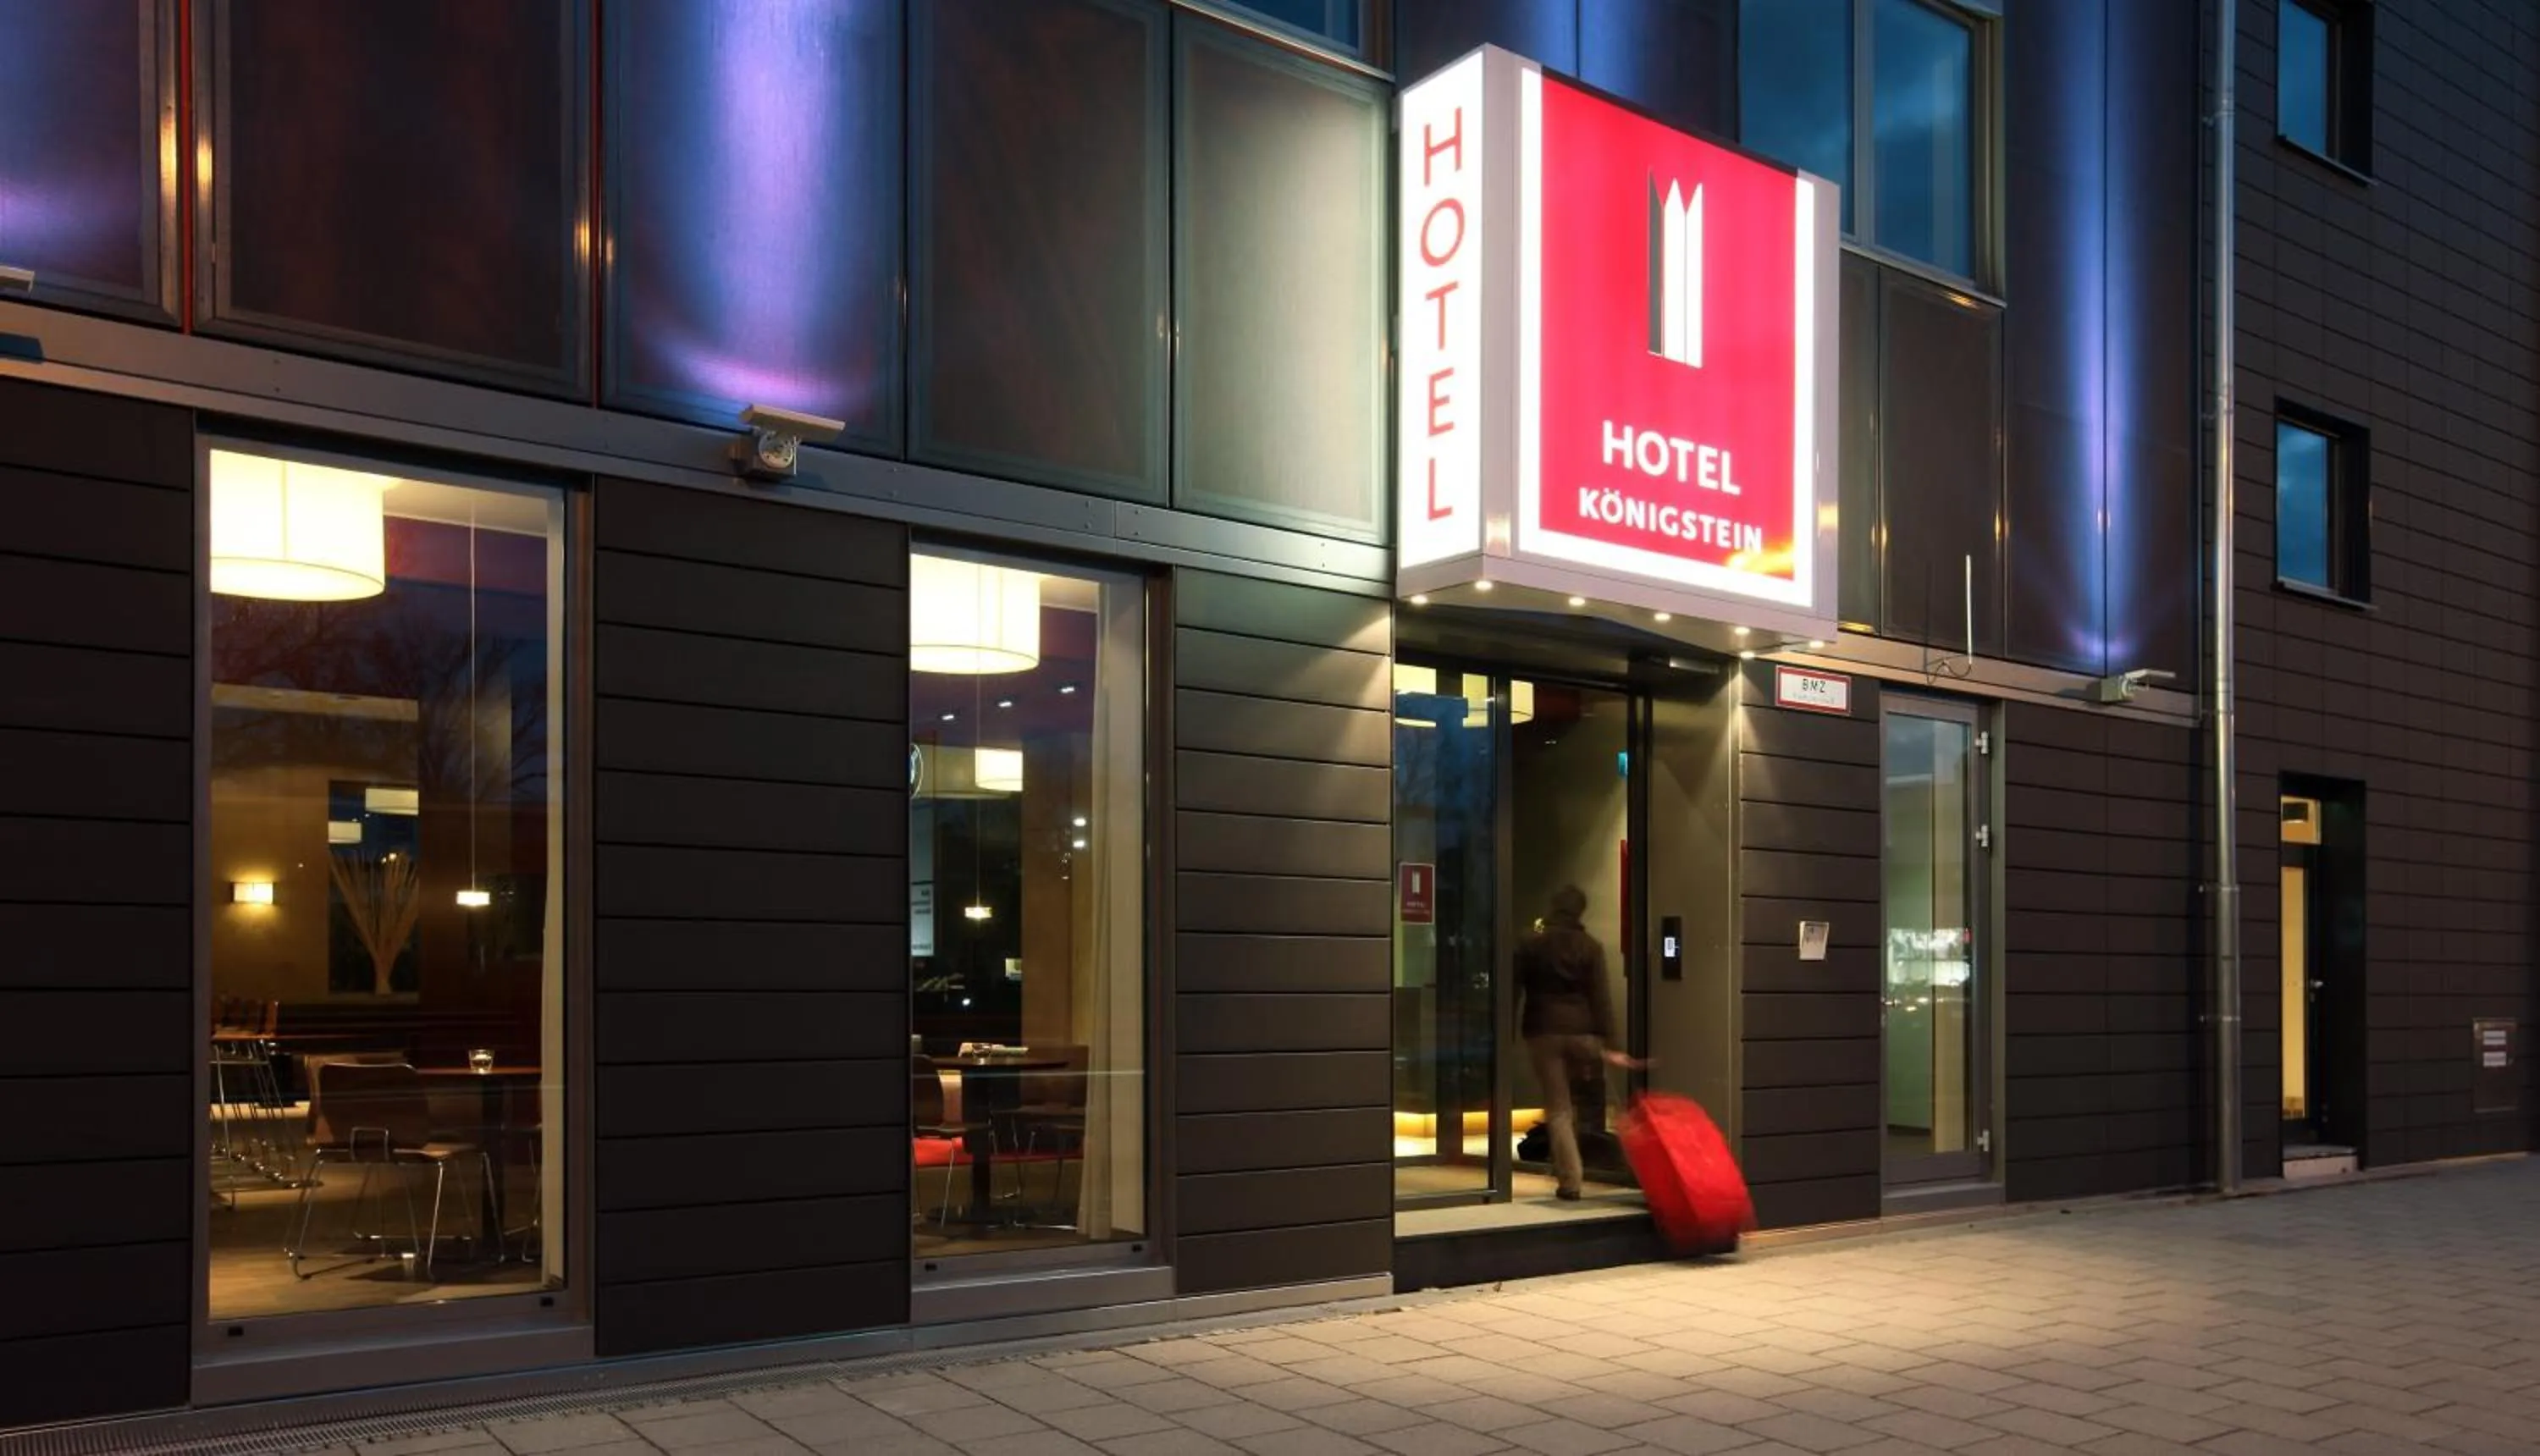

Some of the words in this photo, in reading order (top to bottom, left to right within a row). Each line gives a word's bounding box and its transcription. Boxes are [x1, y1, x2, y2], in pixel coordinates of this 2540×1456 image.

[1420, 107, 1465, 521] HOTEL
[1602, 420, 1741, 495] HOTEL
[1578, 488, 1763, 551] KÖNIGSTEIN
